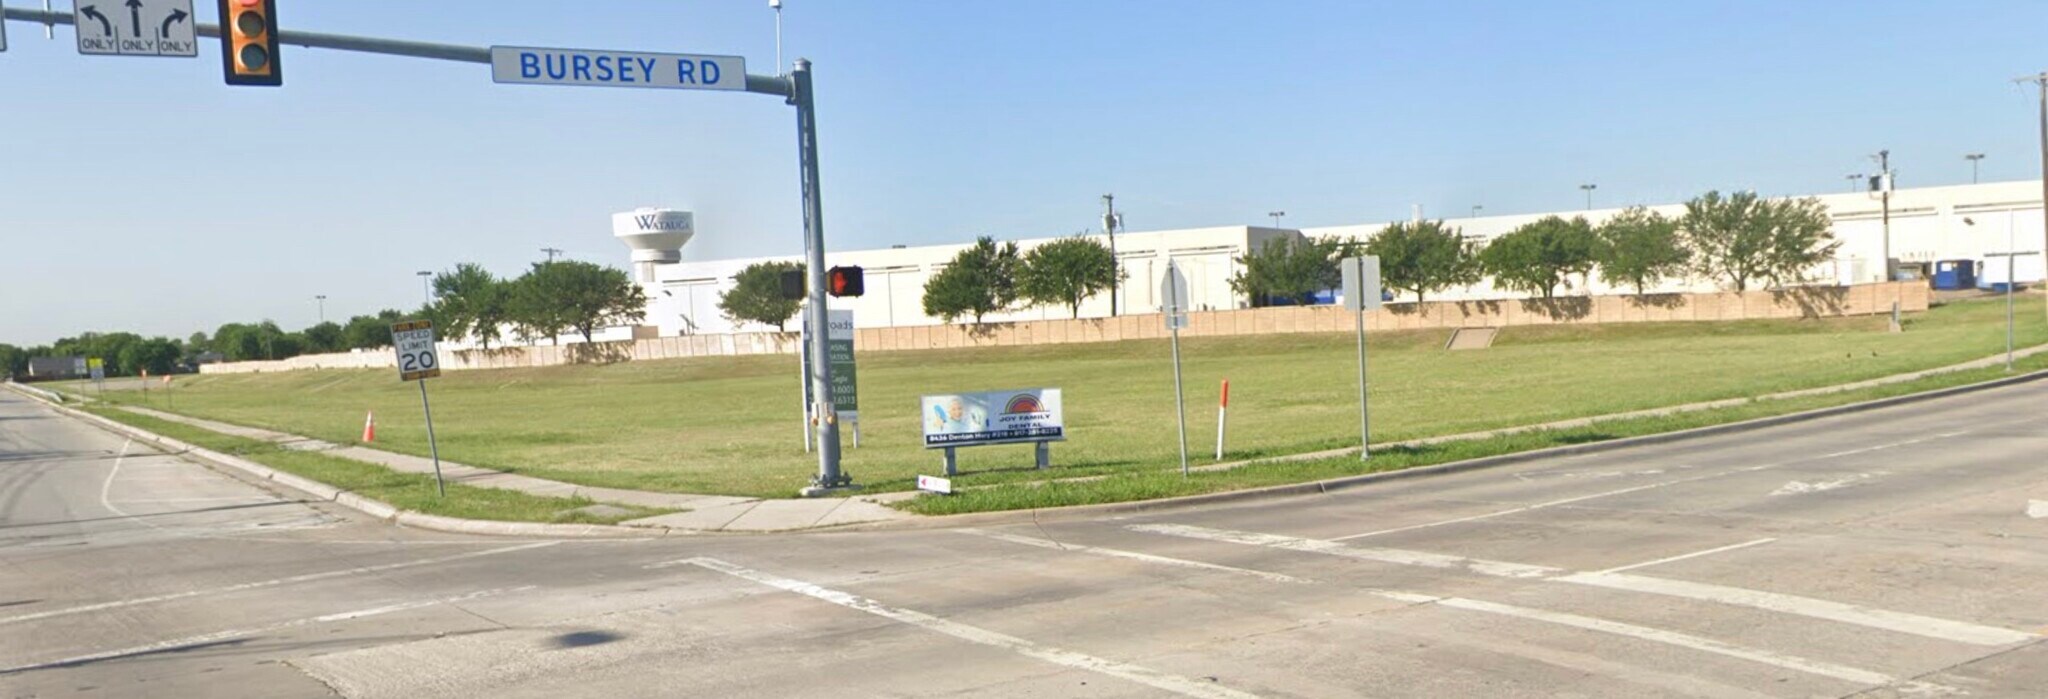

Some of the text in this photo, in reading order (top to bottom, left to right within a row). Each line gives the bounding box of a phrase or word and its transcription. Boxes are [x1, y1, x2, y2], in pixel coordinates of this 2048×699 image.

[82, 38, 114, 50] ONLY
[122, 40, 153, 51] ONLY
[160, 41, 192, 52] ONLY
[520, 52, 721, 85] BURSEY RD
[397, 330, 430, 341] SPEED
[402, 340, 428, 351] LIMIT
[401, 351, 434, 371] 20
[1019, 413, 1051, 421] FAMILY
[1008, 422, 1042, 430] DENTAL
